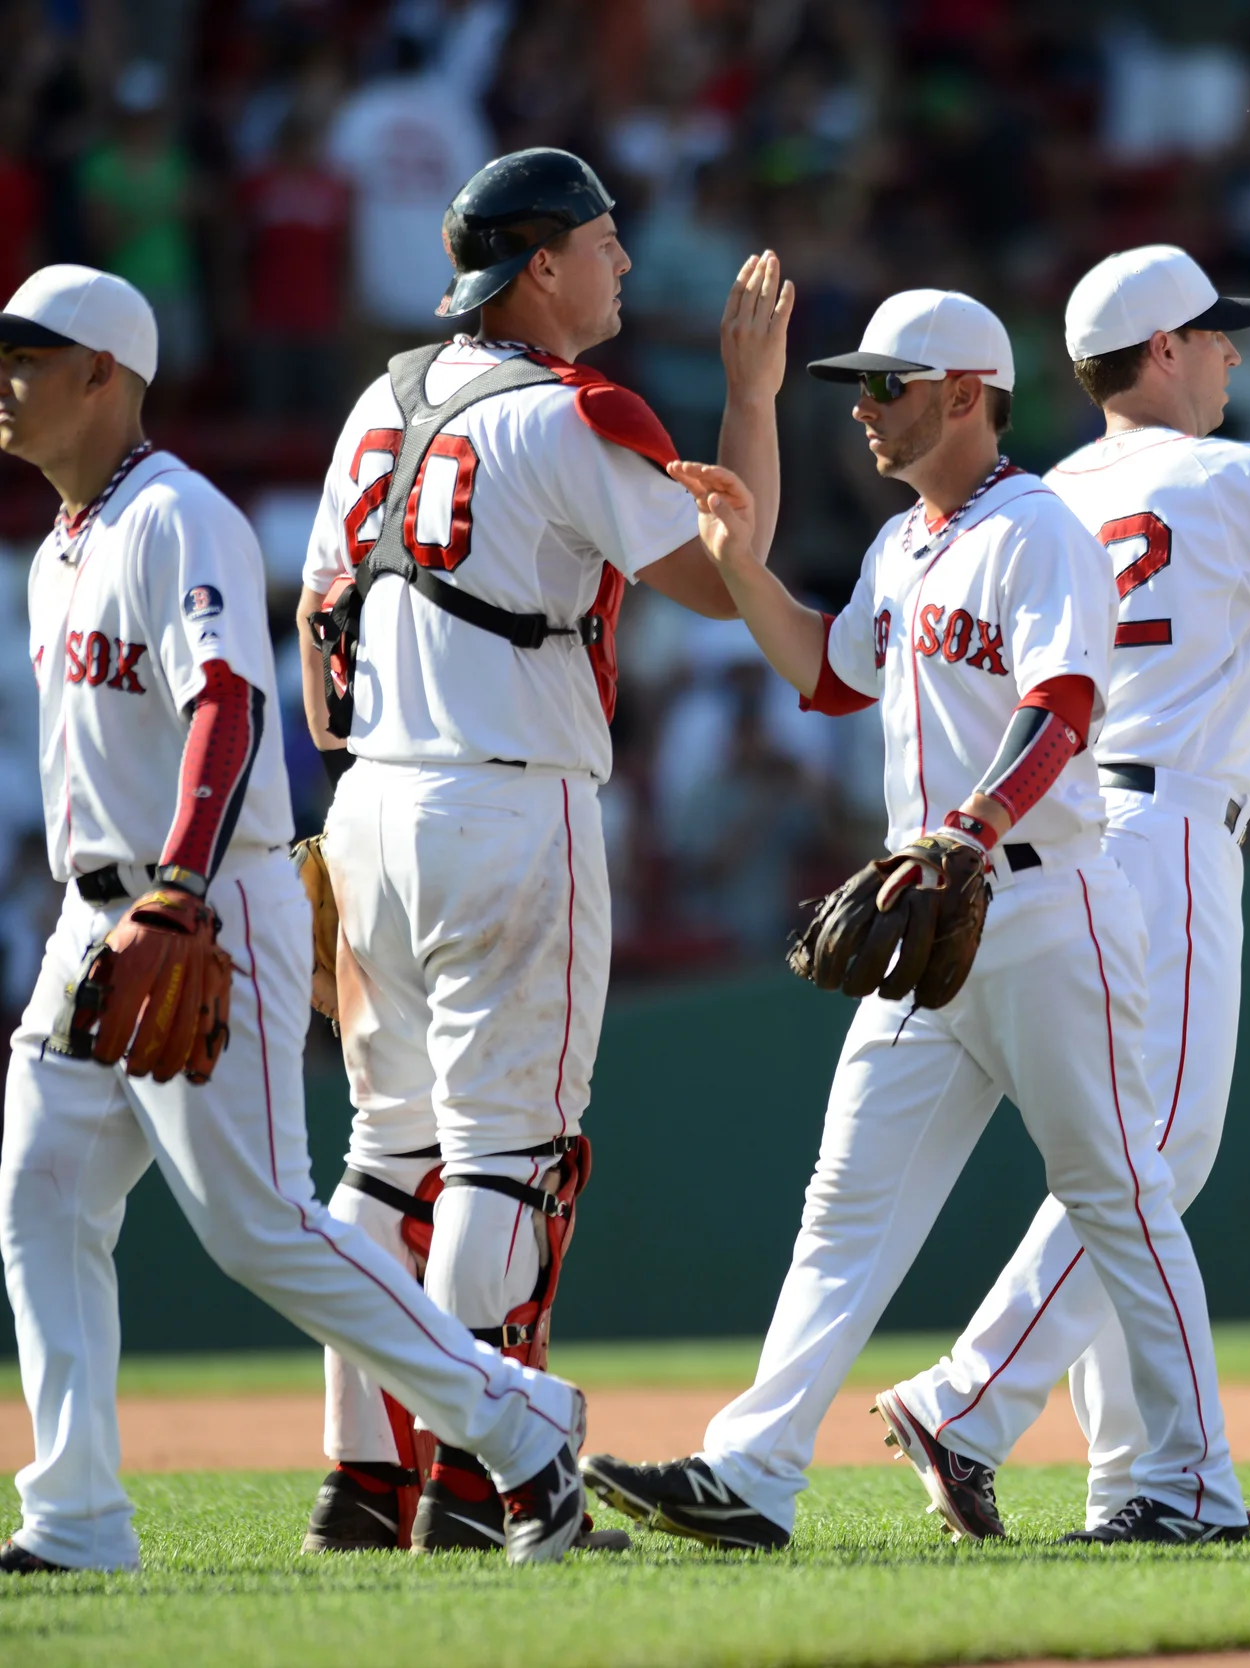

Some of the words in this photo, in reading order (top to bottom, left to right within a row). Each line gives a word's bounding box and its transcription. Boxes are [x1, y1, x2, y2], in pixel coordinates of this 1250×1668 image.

[343, 427, 480, 573] 20
[65, 630, 148, 694] SOX
[914, 603, 1009, 676] SOX
